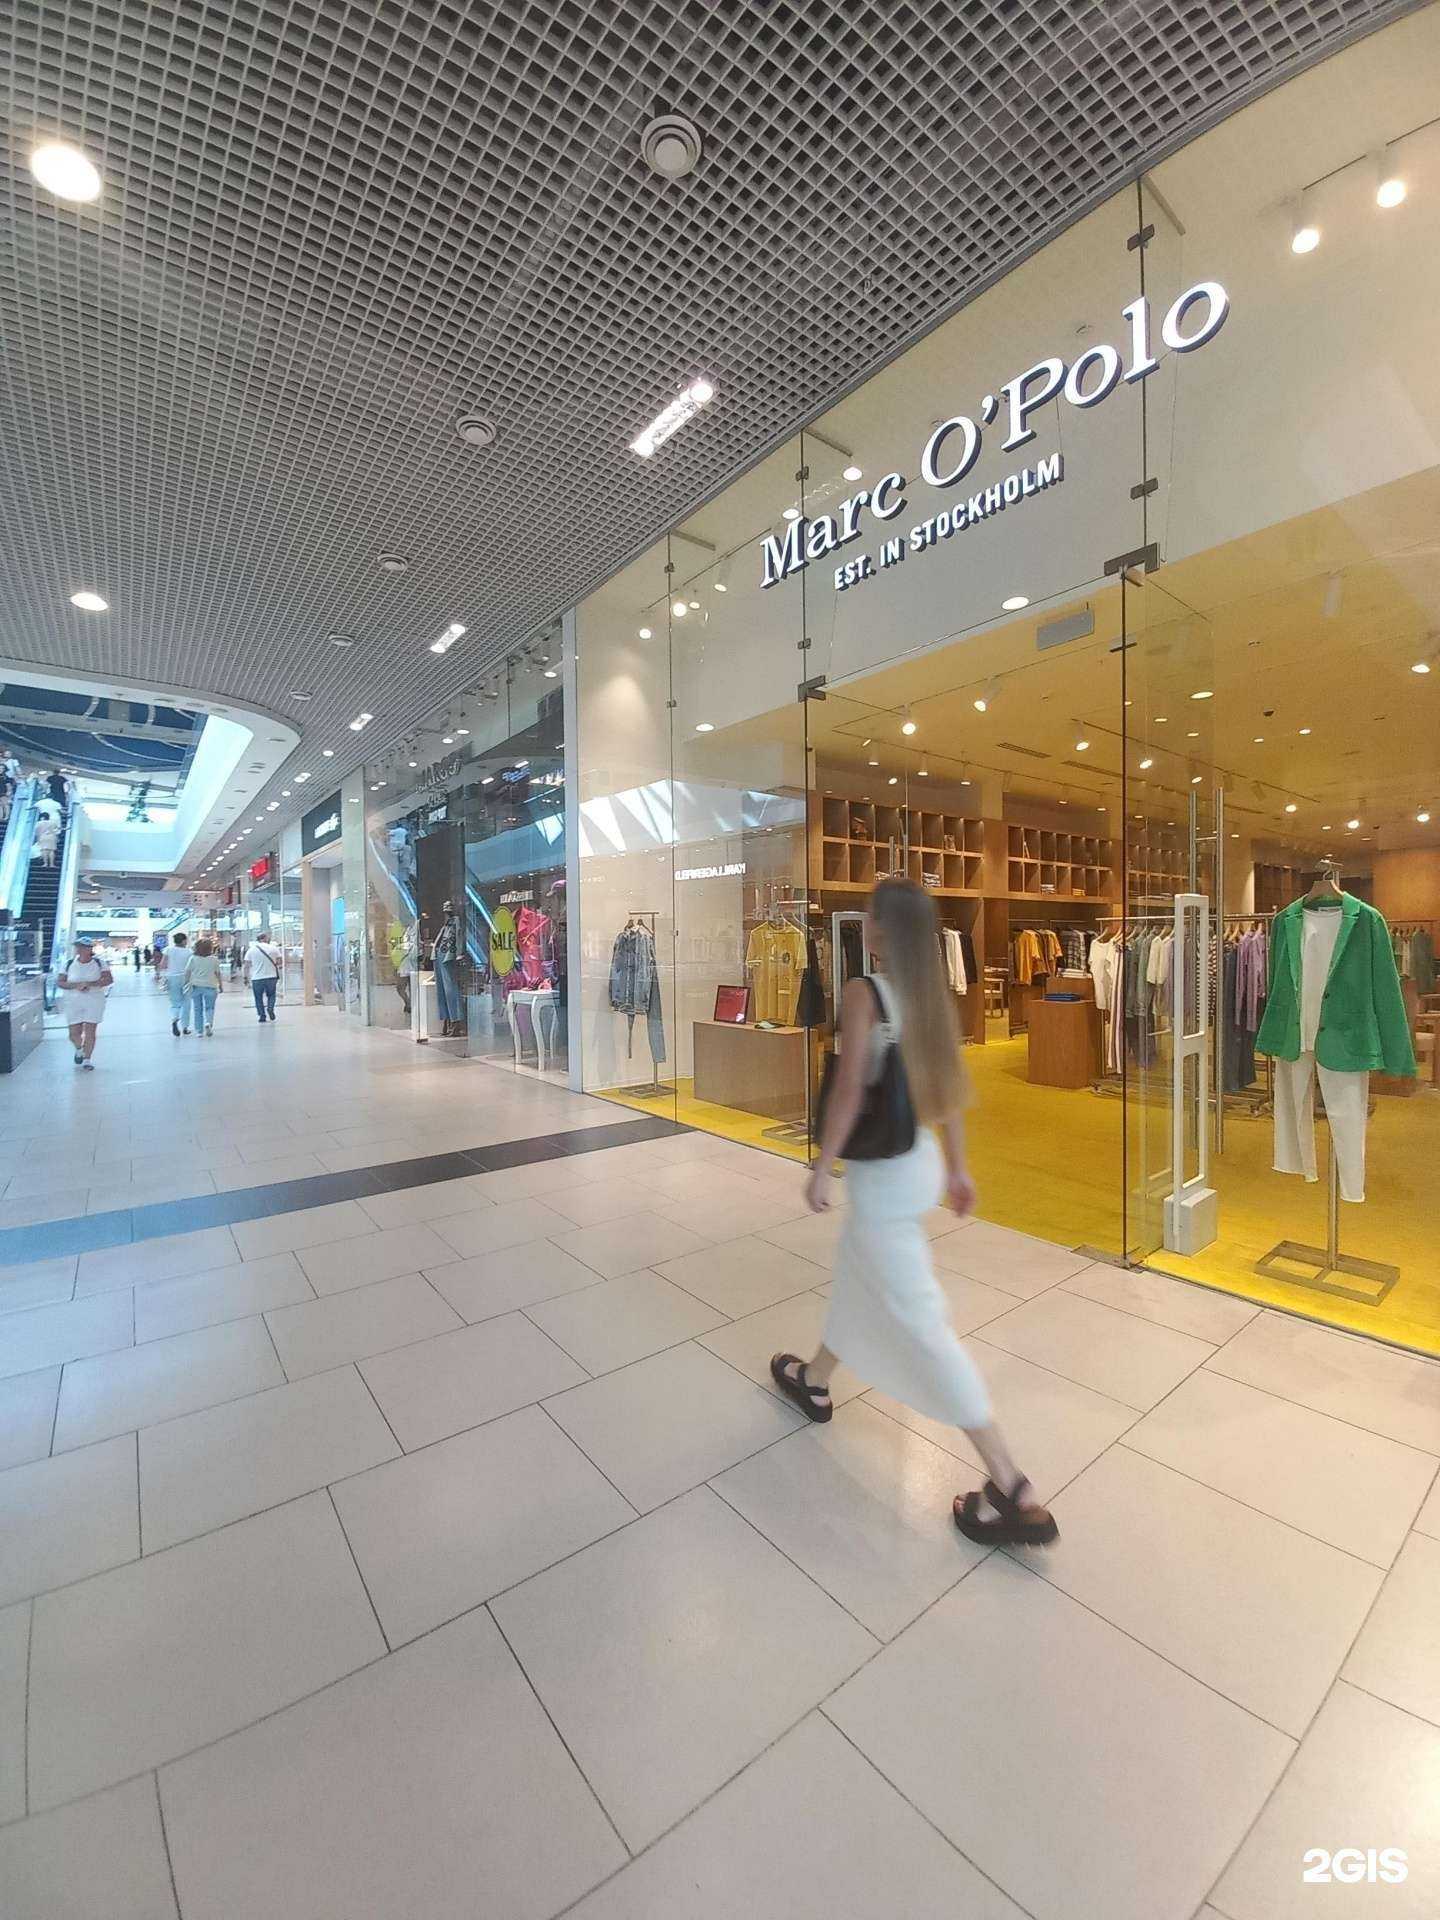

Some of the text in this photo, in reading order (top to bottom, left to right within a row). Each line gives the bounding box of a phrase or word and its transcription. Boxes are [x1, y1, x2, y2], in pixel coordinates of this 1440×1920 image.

[760, 472, 905, 588] Marc
[834, 452, 1062, 590] EST. IN STOCKHOLM
[491, 931, 514, 951] SALE
